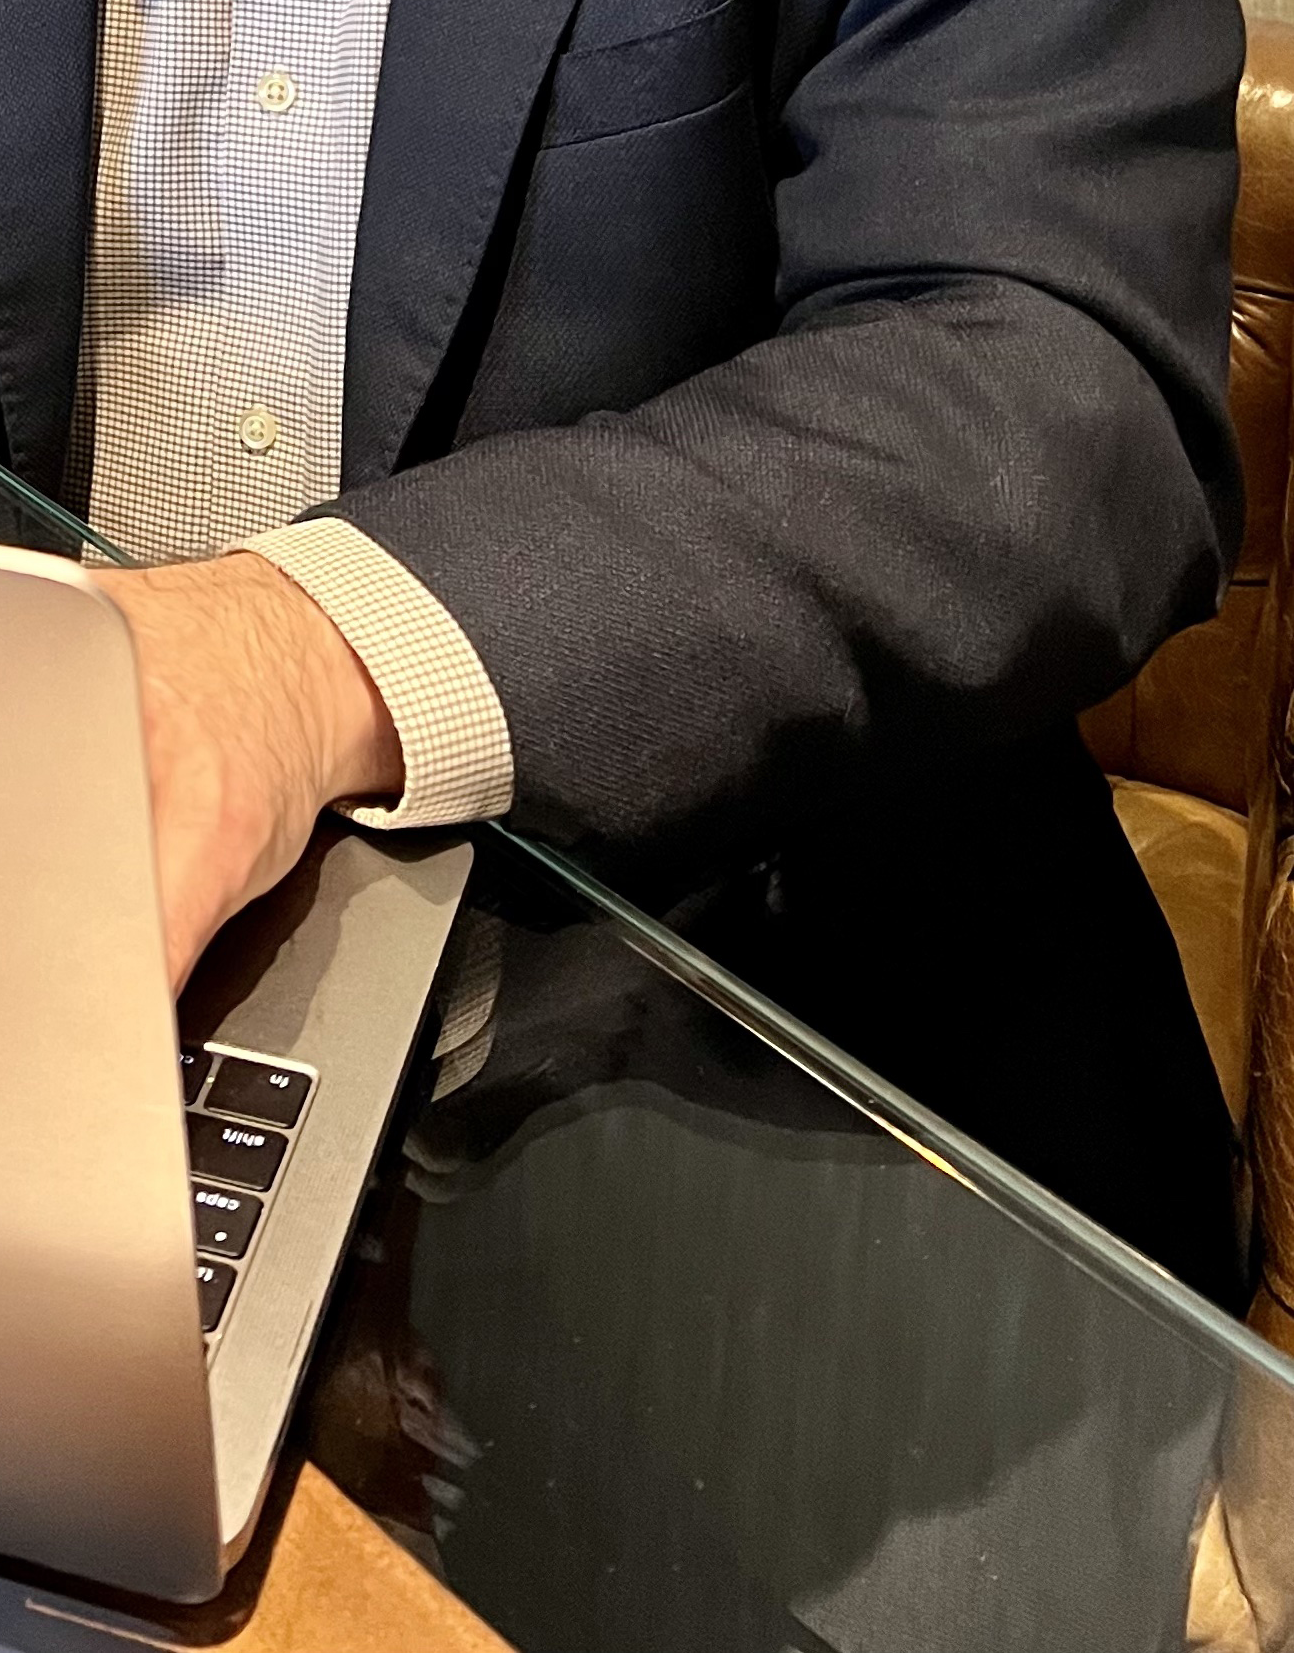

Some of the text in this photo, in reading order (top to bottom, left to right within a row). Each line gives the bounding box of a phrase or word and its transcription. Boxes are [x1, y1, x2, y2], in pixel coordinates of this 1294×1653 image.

[270, 1074, 290, 1089] fn
[222, 1128, 266, 1147] shift
[196, 1191, 241, 1210] caps
